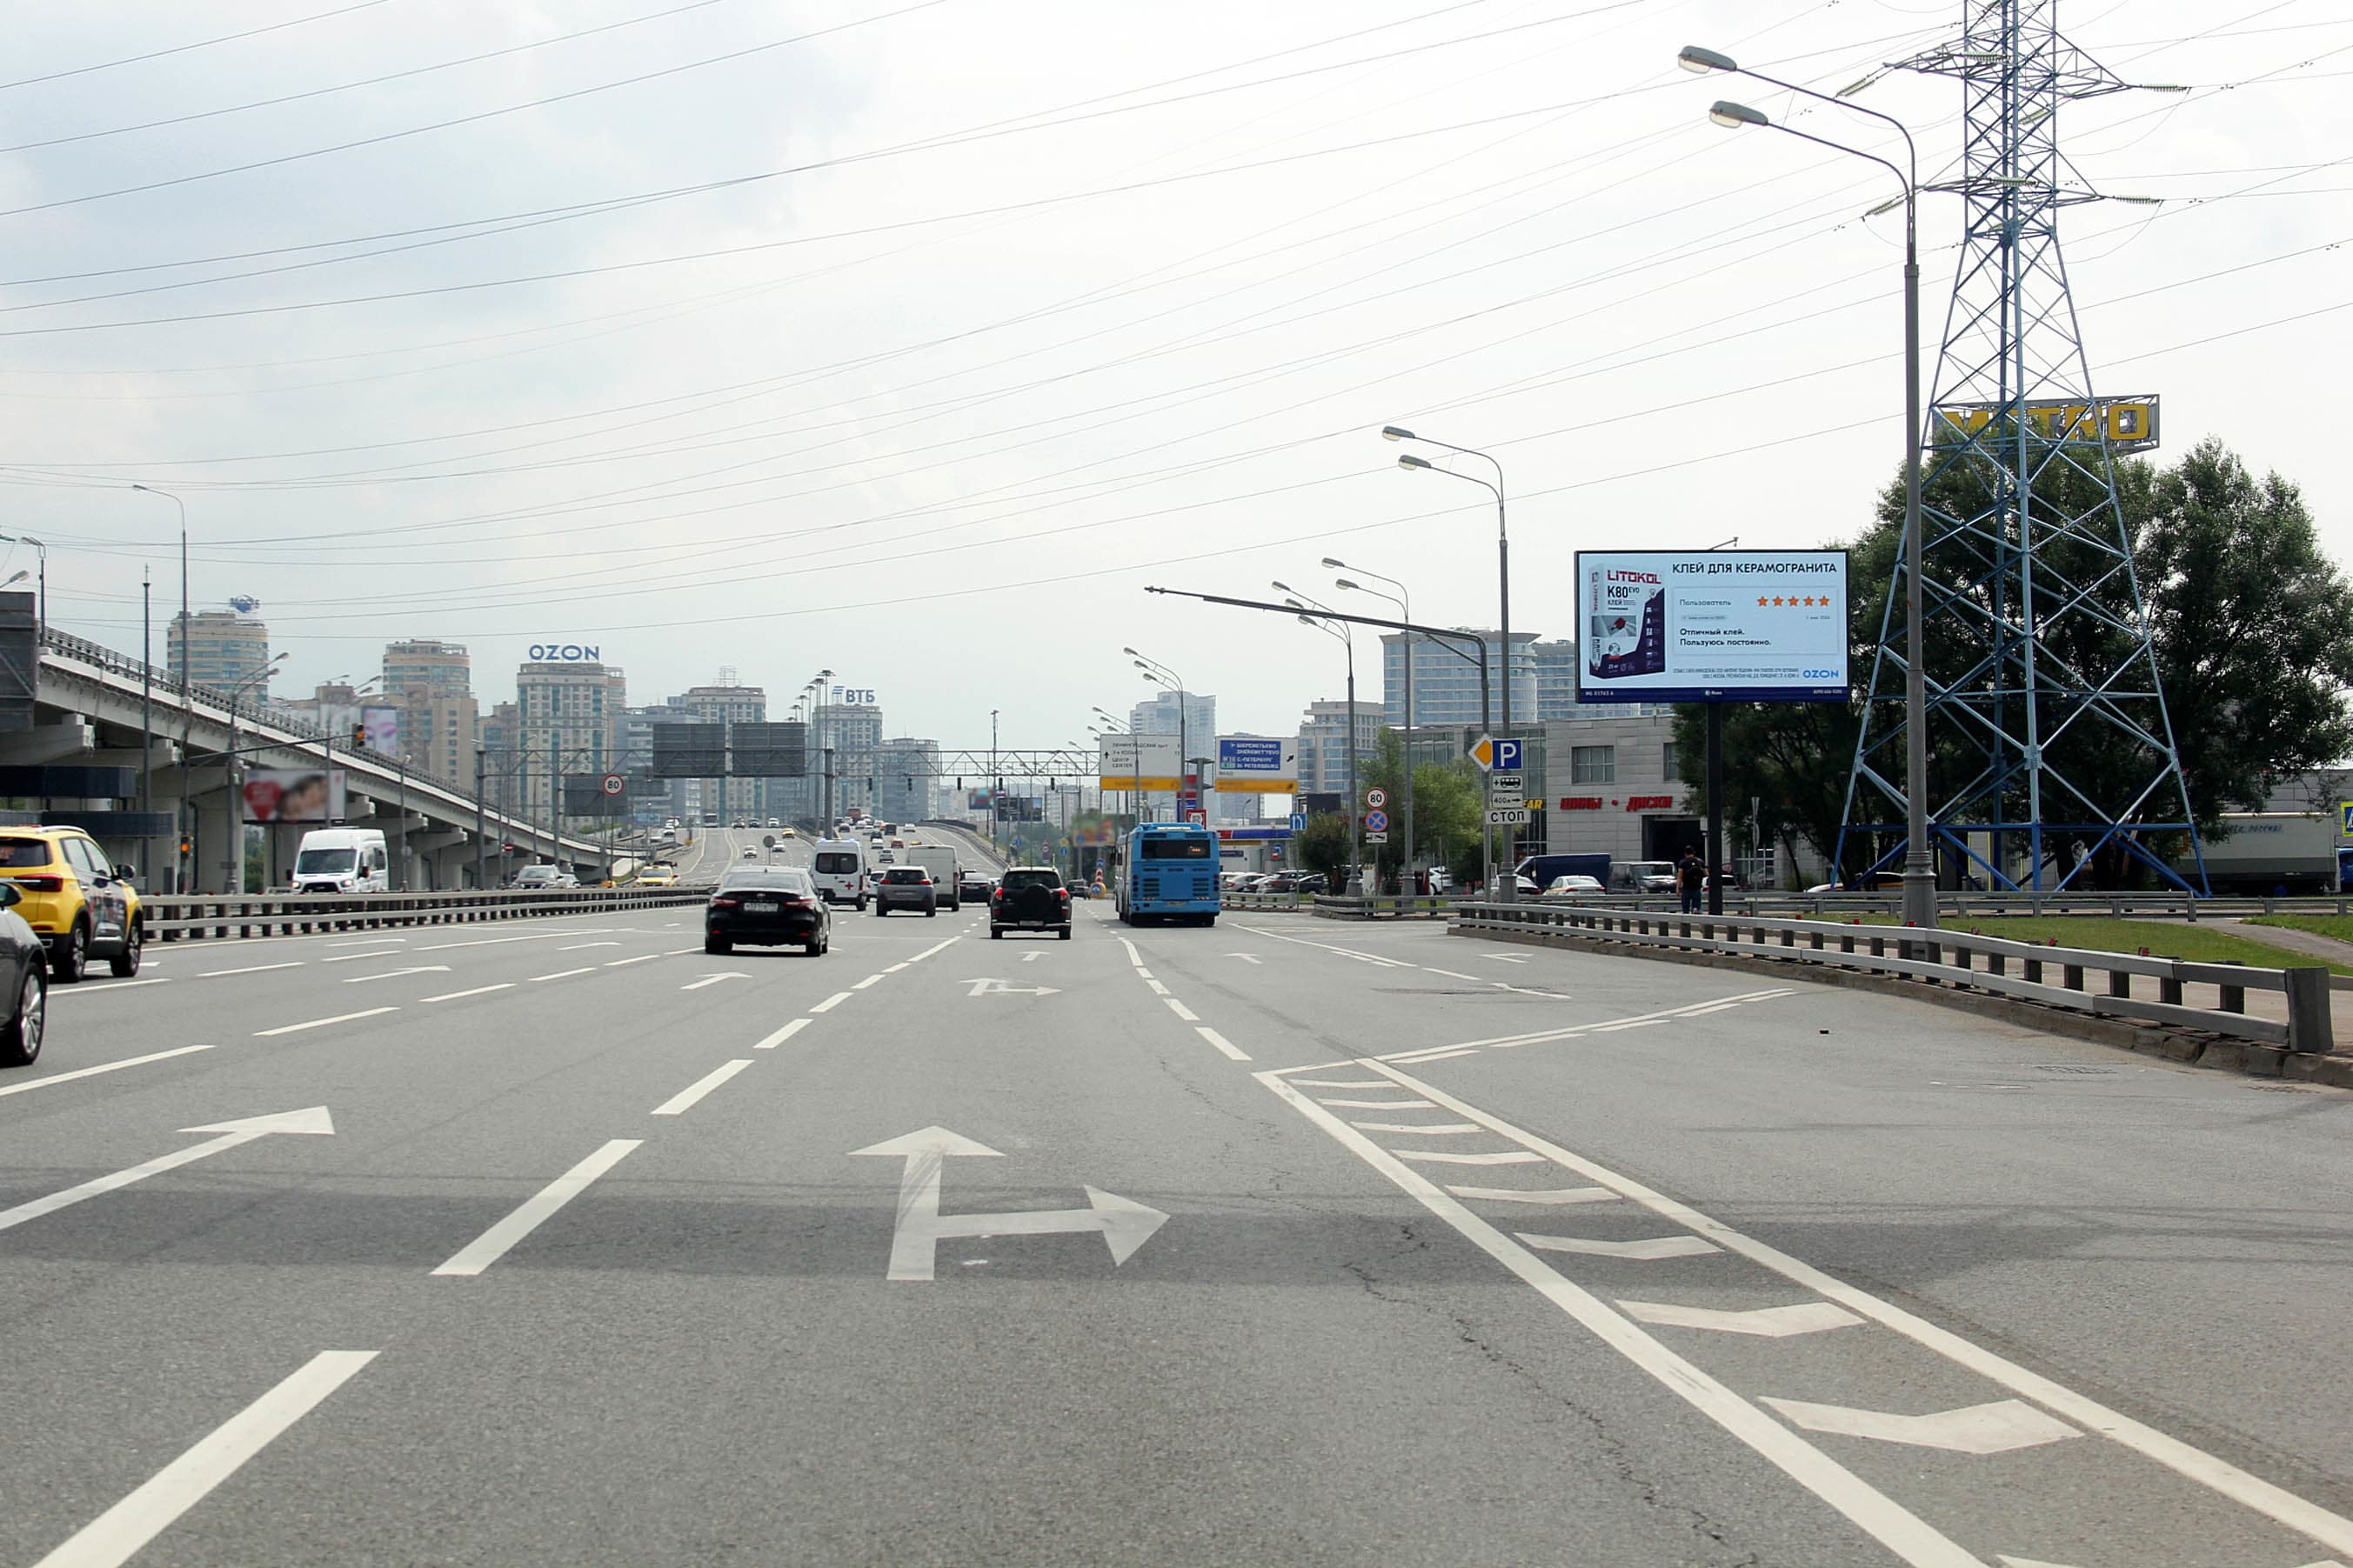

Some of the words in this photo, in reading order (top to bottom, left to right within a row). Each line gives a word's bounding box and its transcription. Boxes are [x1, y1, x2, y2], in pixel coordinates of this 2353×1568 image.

[1672, 563, 1704, 573] КЛЕЙ
[1708, 564, 1732, 575] ДЛЯ
[1736, 564, 1837, 573] КЕРАМОГРАНИТА
[1608, 570, 1661, 584] LITOKOL
[1608, 585, 1628, 597] K80
[1680, 638, 1724, 647] Пользуюсь
[529, 644, 599, 660] OZON
[1802, 670, 1839, 678] OZON
[846, 690, 875, 703] ВТБ
[1500, 743, 1517, 766] P
[1370, 793, 1382, 803] 80
[1626, 796, 1673, 811] ДИСКИ
[1491, 811, 1524, 822] СТОП
